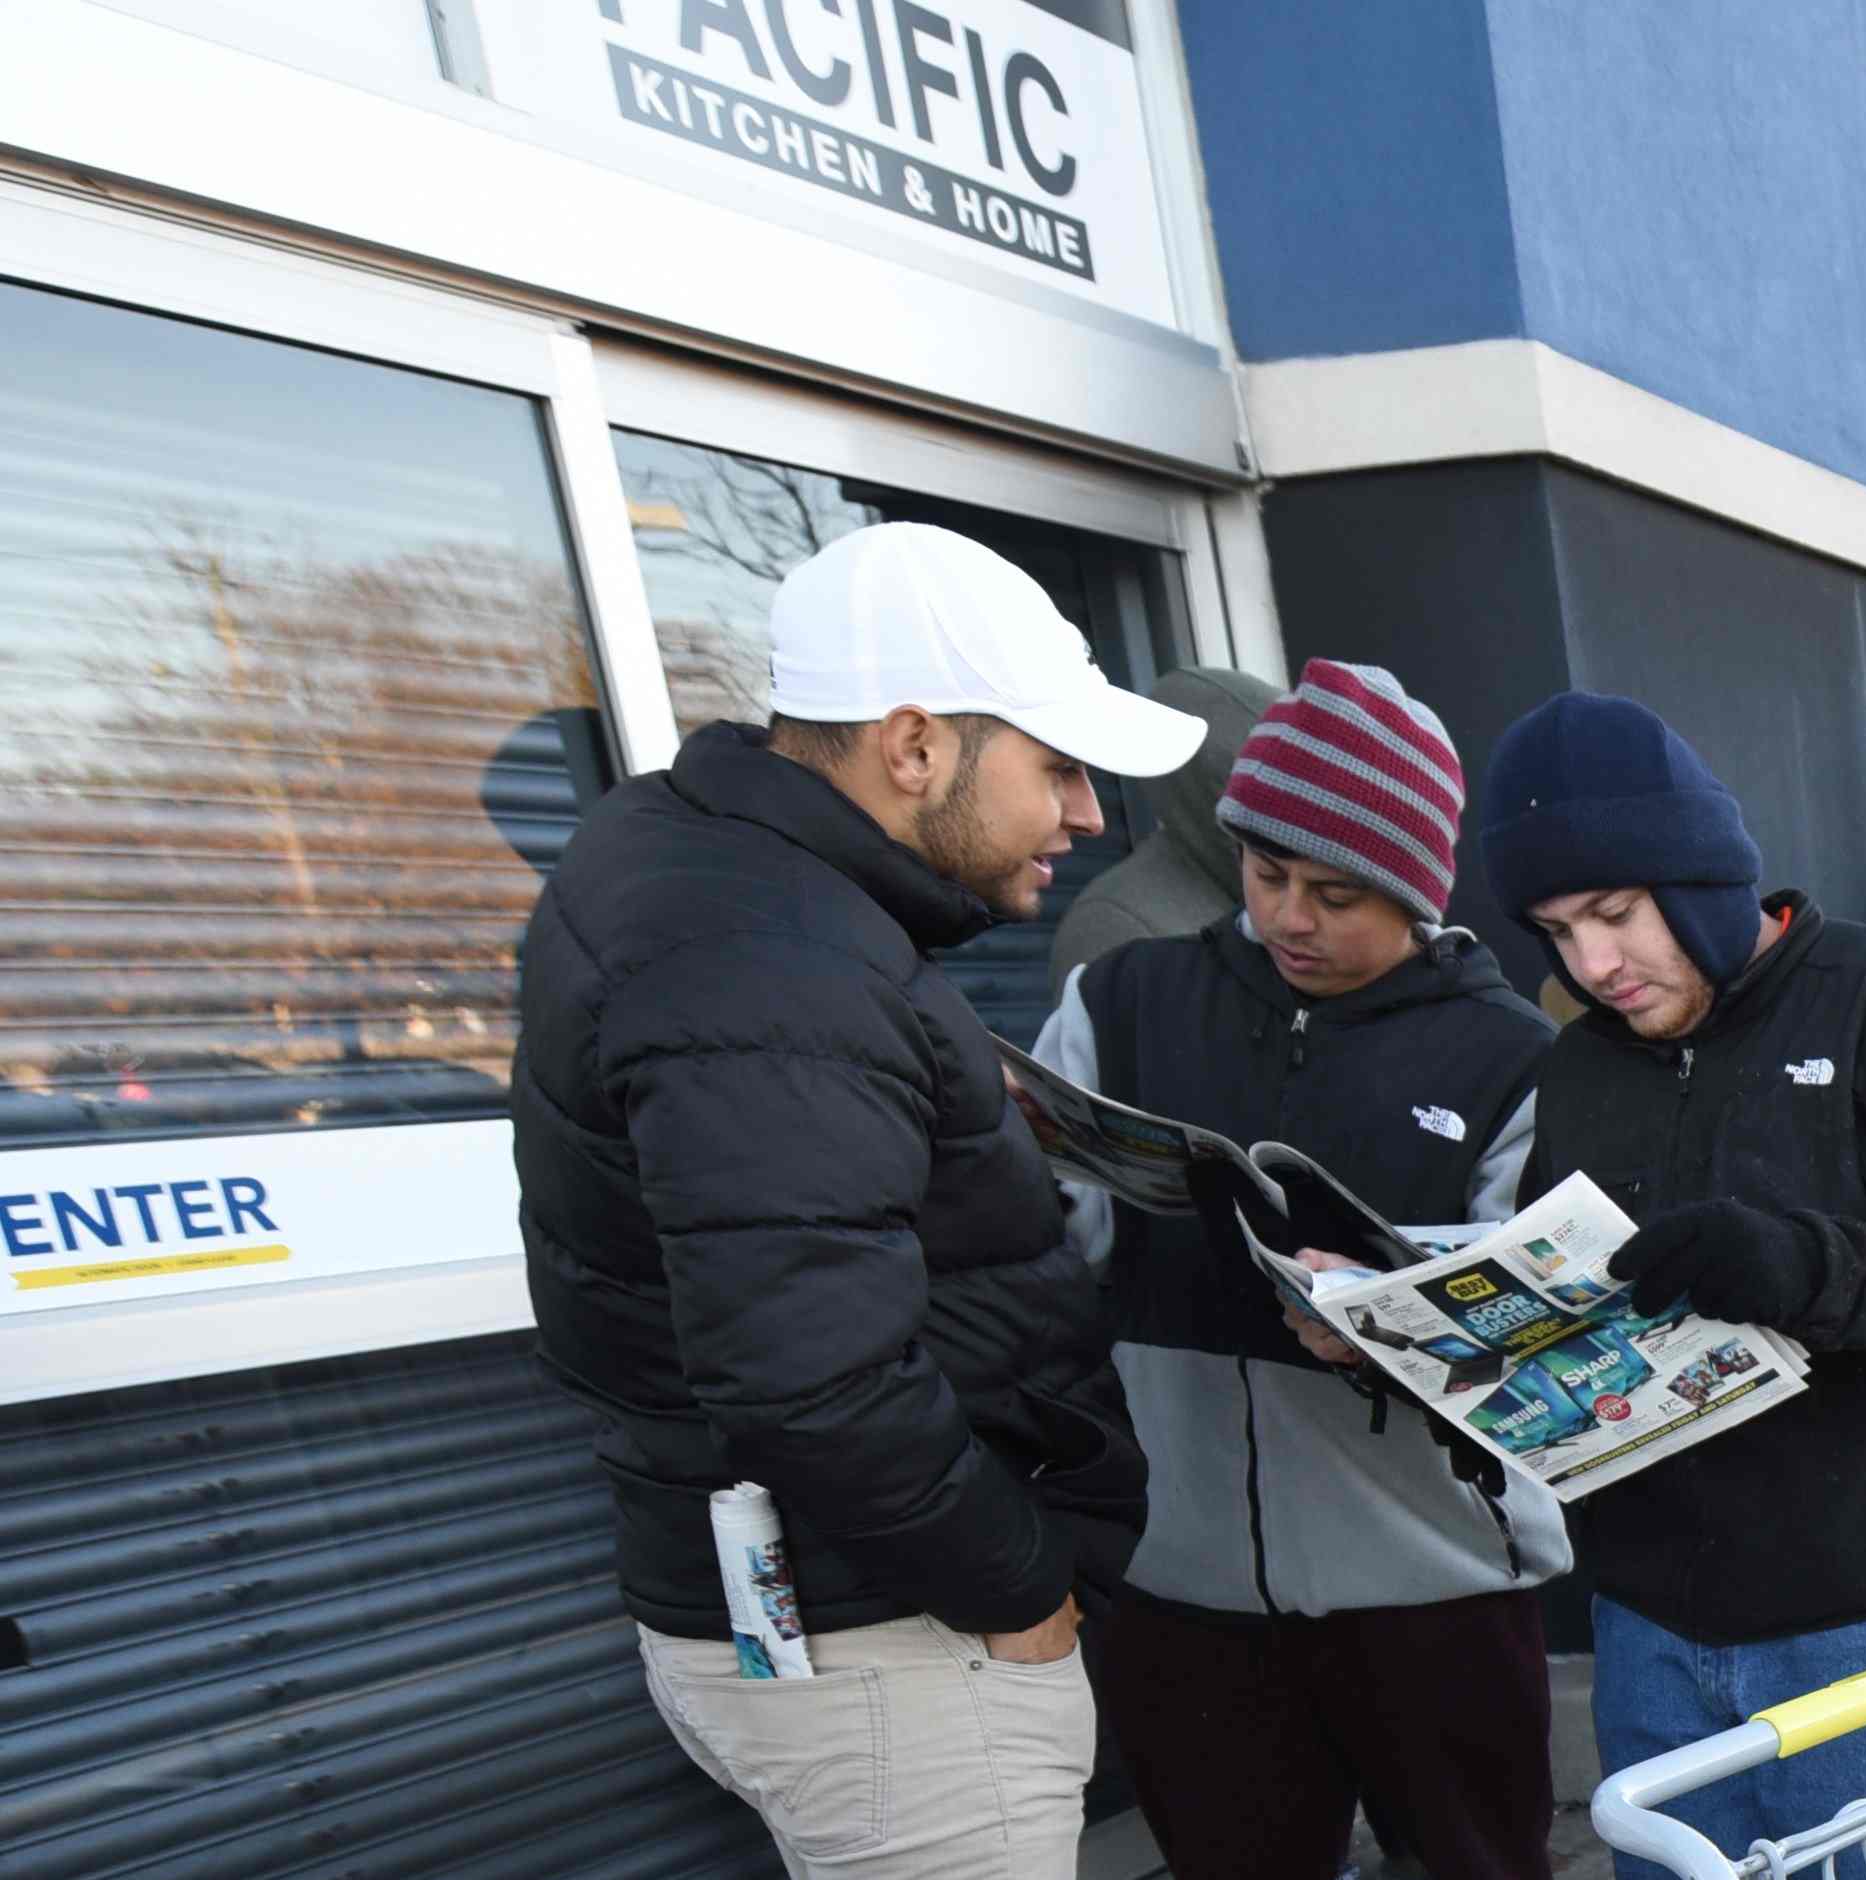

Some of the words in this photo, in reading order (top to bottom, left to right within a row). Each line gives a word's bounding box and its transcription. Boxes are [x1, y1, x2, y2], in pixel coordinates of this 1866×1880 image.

[596, 0, 1077, 198] ACIFIC
[627, 62, 884, 196] KITCHEN
[903, 164, 936, 216] &
[952, 181, 1086, 269] HOME
[0, 1176, 279, 1257] ENTER
[1465, 1295, 1532, 1326] DOOR
[1474, 1301, 1548, 1337] BUSTERS
[1561, 1350, 1621, 1388] SHARP
[1491, 1399, 1550, 1435] SAMSUNG
